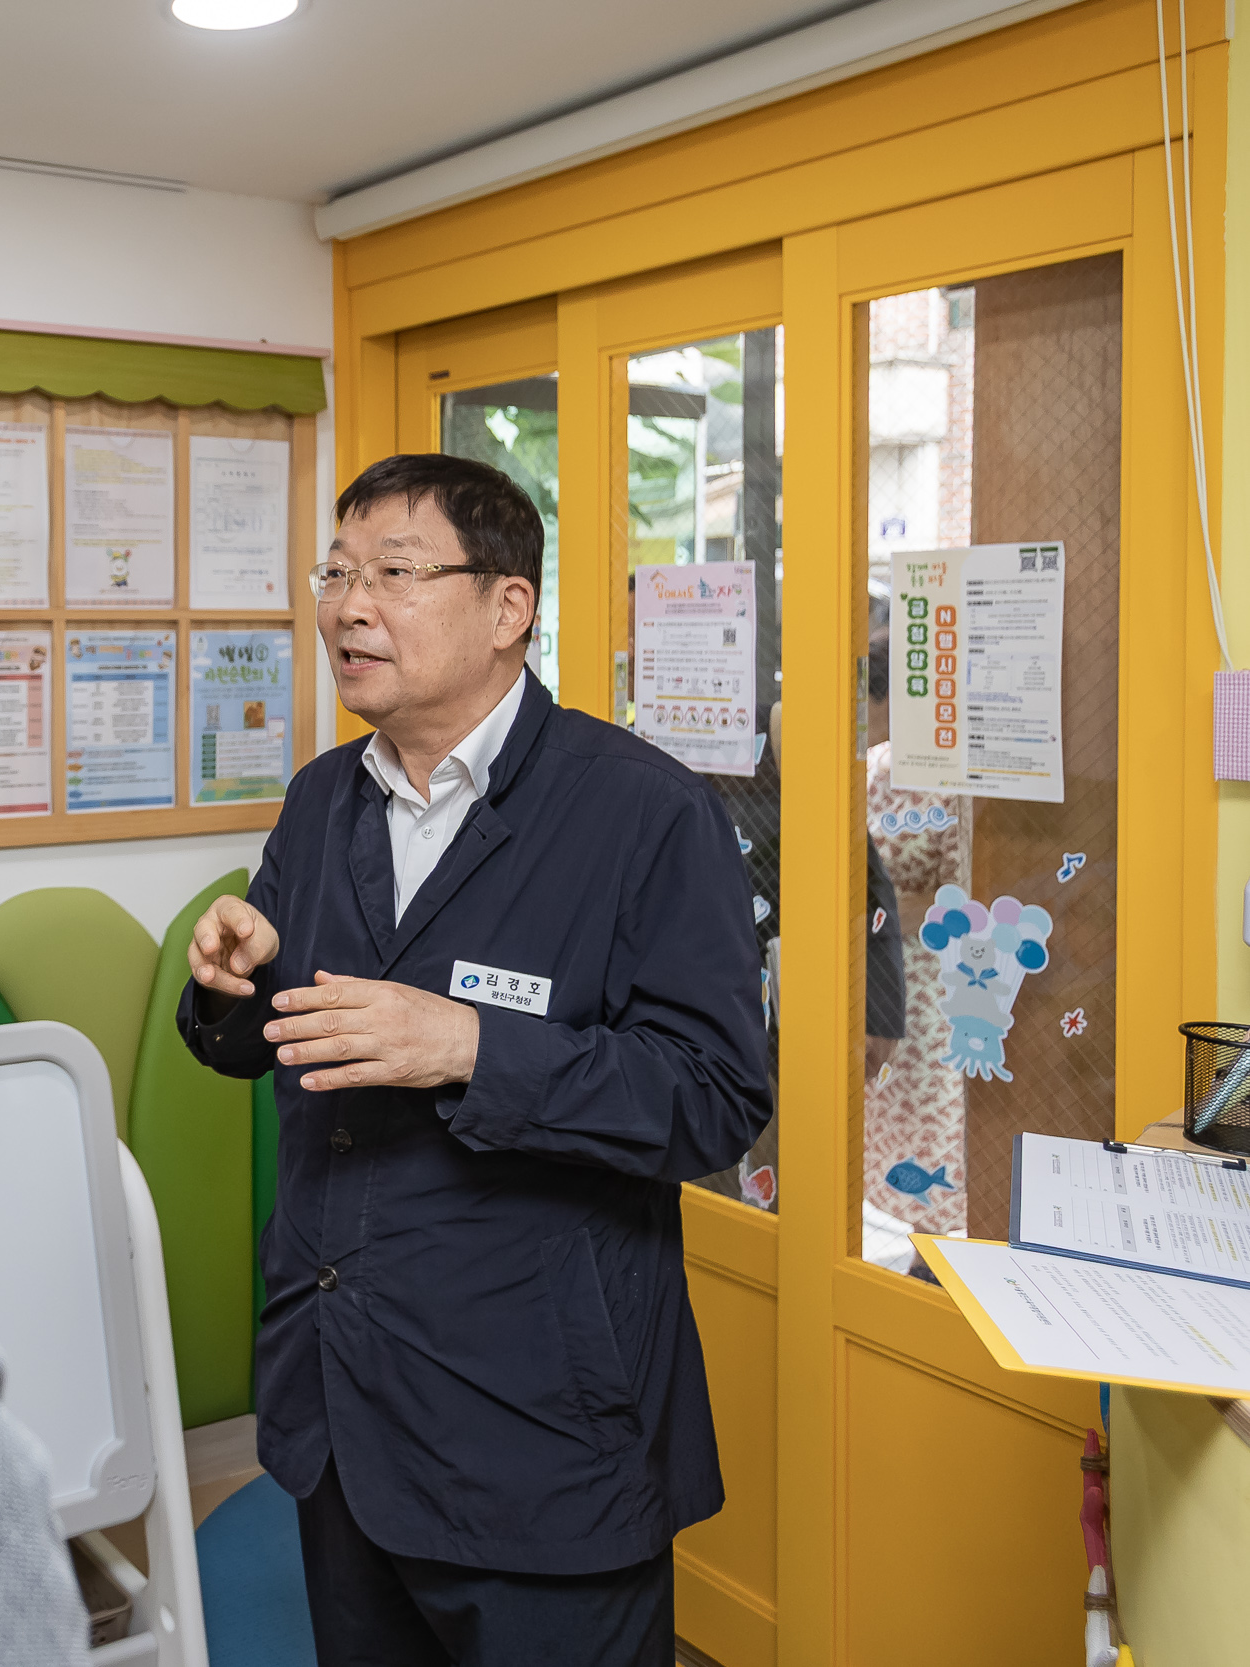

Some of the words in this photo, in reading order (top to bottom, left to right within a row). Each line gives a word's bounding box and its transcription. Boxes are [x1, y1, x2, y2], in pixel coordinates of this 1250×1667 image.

[266, 660, 279, 684] 날
[486, 973, 541, 995] 김경호
[491, 990, 532, 1006] 광진구청장
